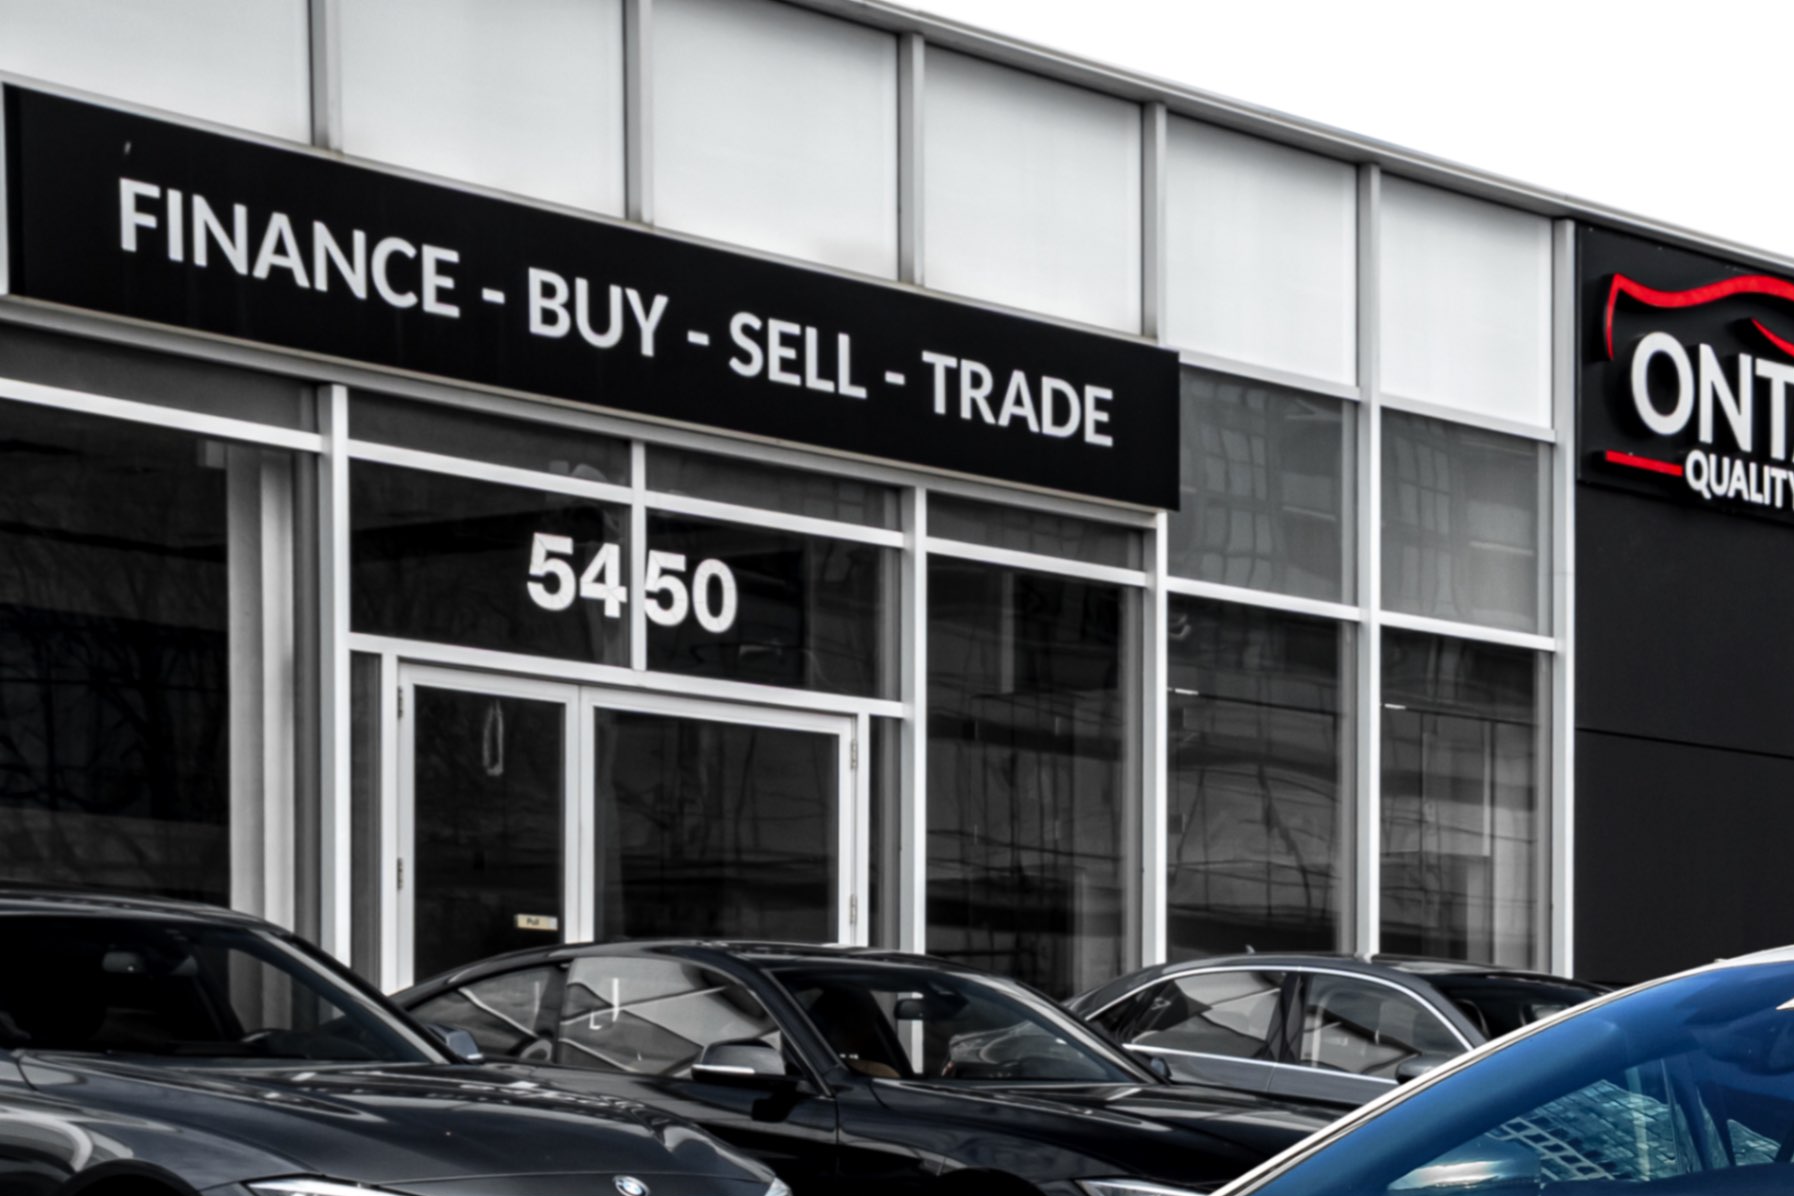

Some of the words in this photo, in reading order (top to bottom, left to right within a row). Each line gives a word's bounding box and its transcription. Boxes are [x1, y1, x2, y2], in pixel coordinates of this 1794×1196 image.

[119, 177, 461, 318] FINANCE
[528, 267, 669, 357] BUY
[729, 311, 867, 399] SELL
[921, 350, 1113, 447] TRADE
[527, 532, 738, 633] 5450
